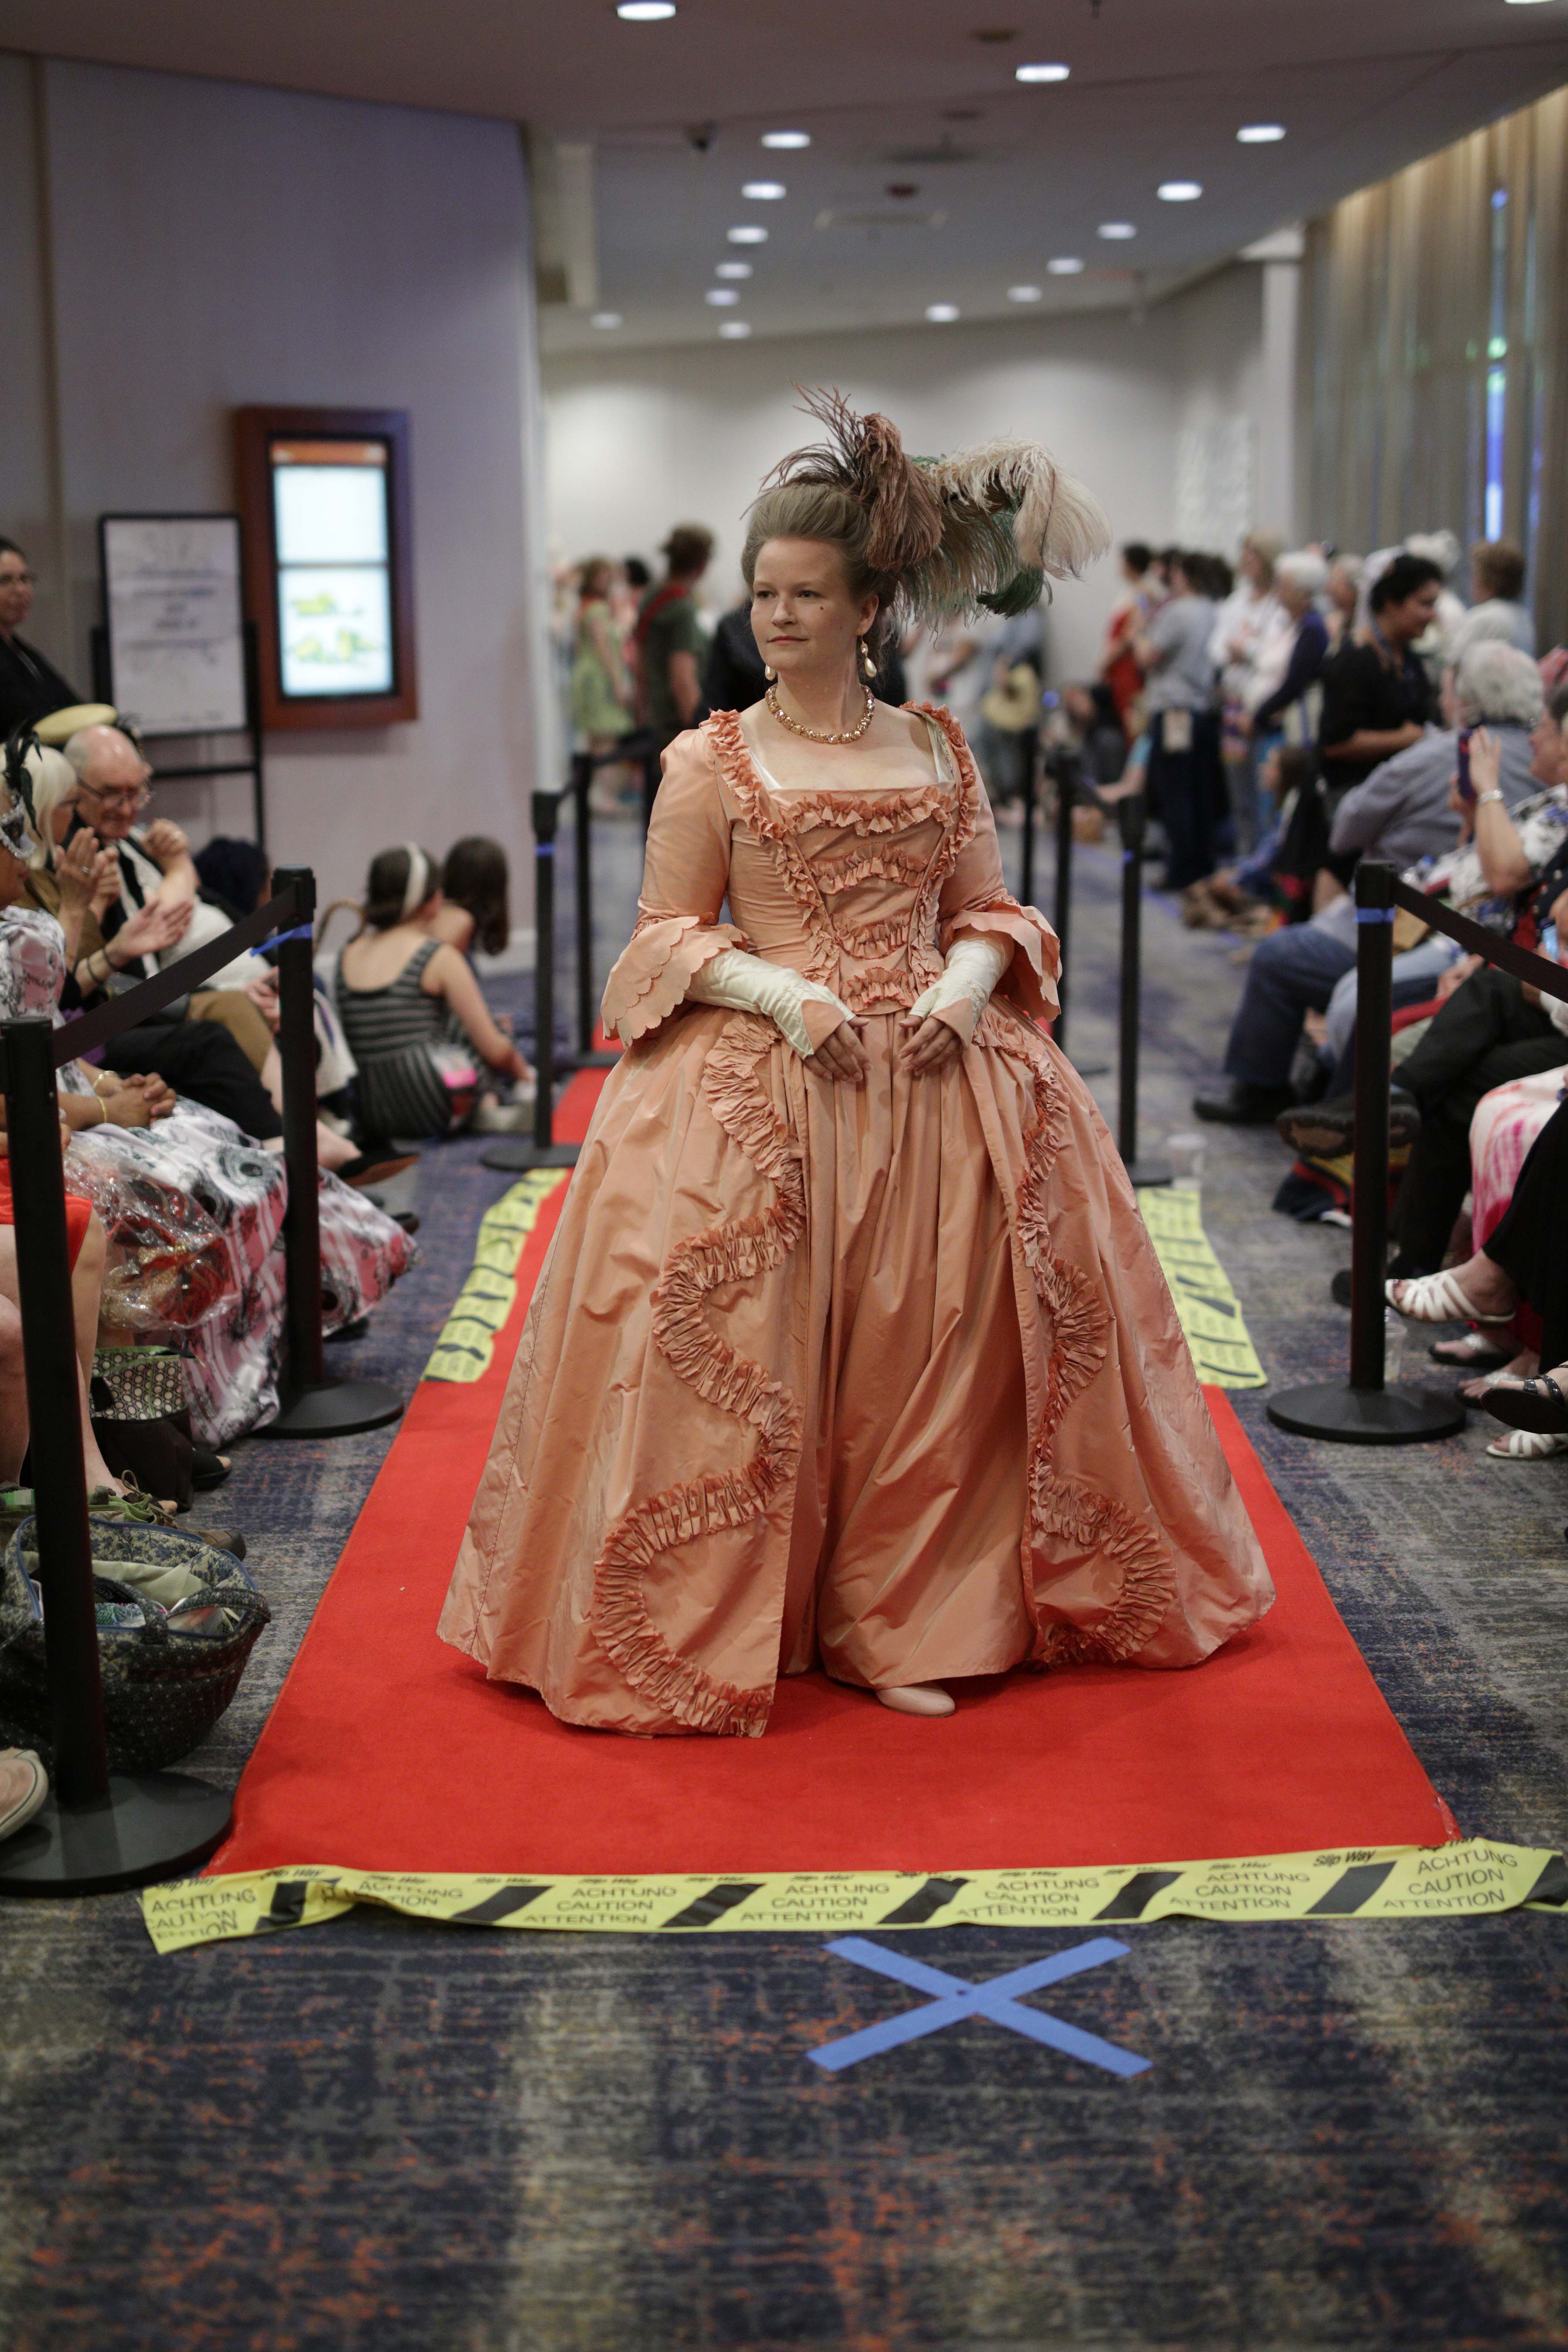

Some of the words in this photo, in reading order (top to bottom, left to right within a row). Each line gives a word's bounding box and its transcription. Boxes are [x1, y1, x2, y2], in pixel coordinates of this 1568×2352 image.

[1417, 1848, 1518, 1875] ACHTUNG
[1206, 1872, 1310, 1883] ACHTUNG
[1408, 1868, 1504, 1895] CAUTION
[785, 1883, 890, 1895] ACHTUNG
[996, 1878, 1100, 1892] ACHTUNG
[1195, 1883, 1292, 1897] CAUTION
[571, 1886, 677, 1899] ACHTUNG
[984, 1890, 1080, 1905] CAUTION
[1383, 1889, 1505, 1909] ATTENTION
[152, 1888, 256, 1913] ACHTUNG
[557, 1900, 653, 1912] CAUTION
[771, 1896, 868, 1909] CAUTION
[1169, 1896, 1291, 1912] ATTENTION
[740, 1910, 864, 1923] ATTENTION
[956, 1903, 1078, 1917] ATTENTION
[524, 1913, 648, 1925] ATTENTION
